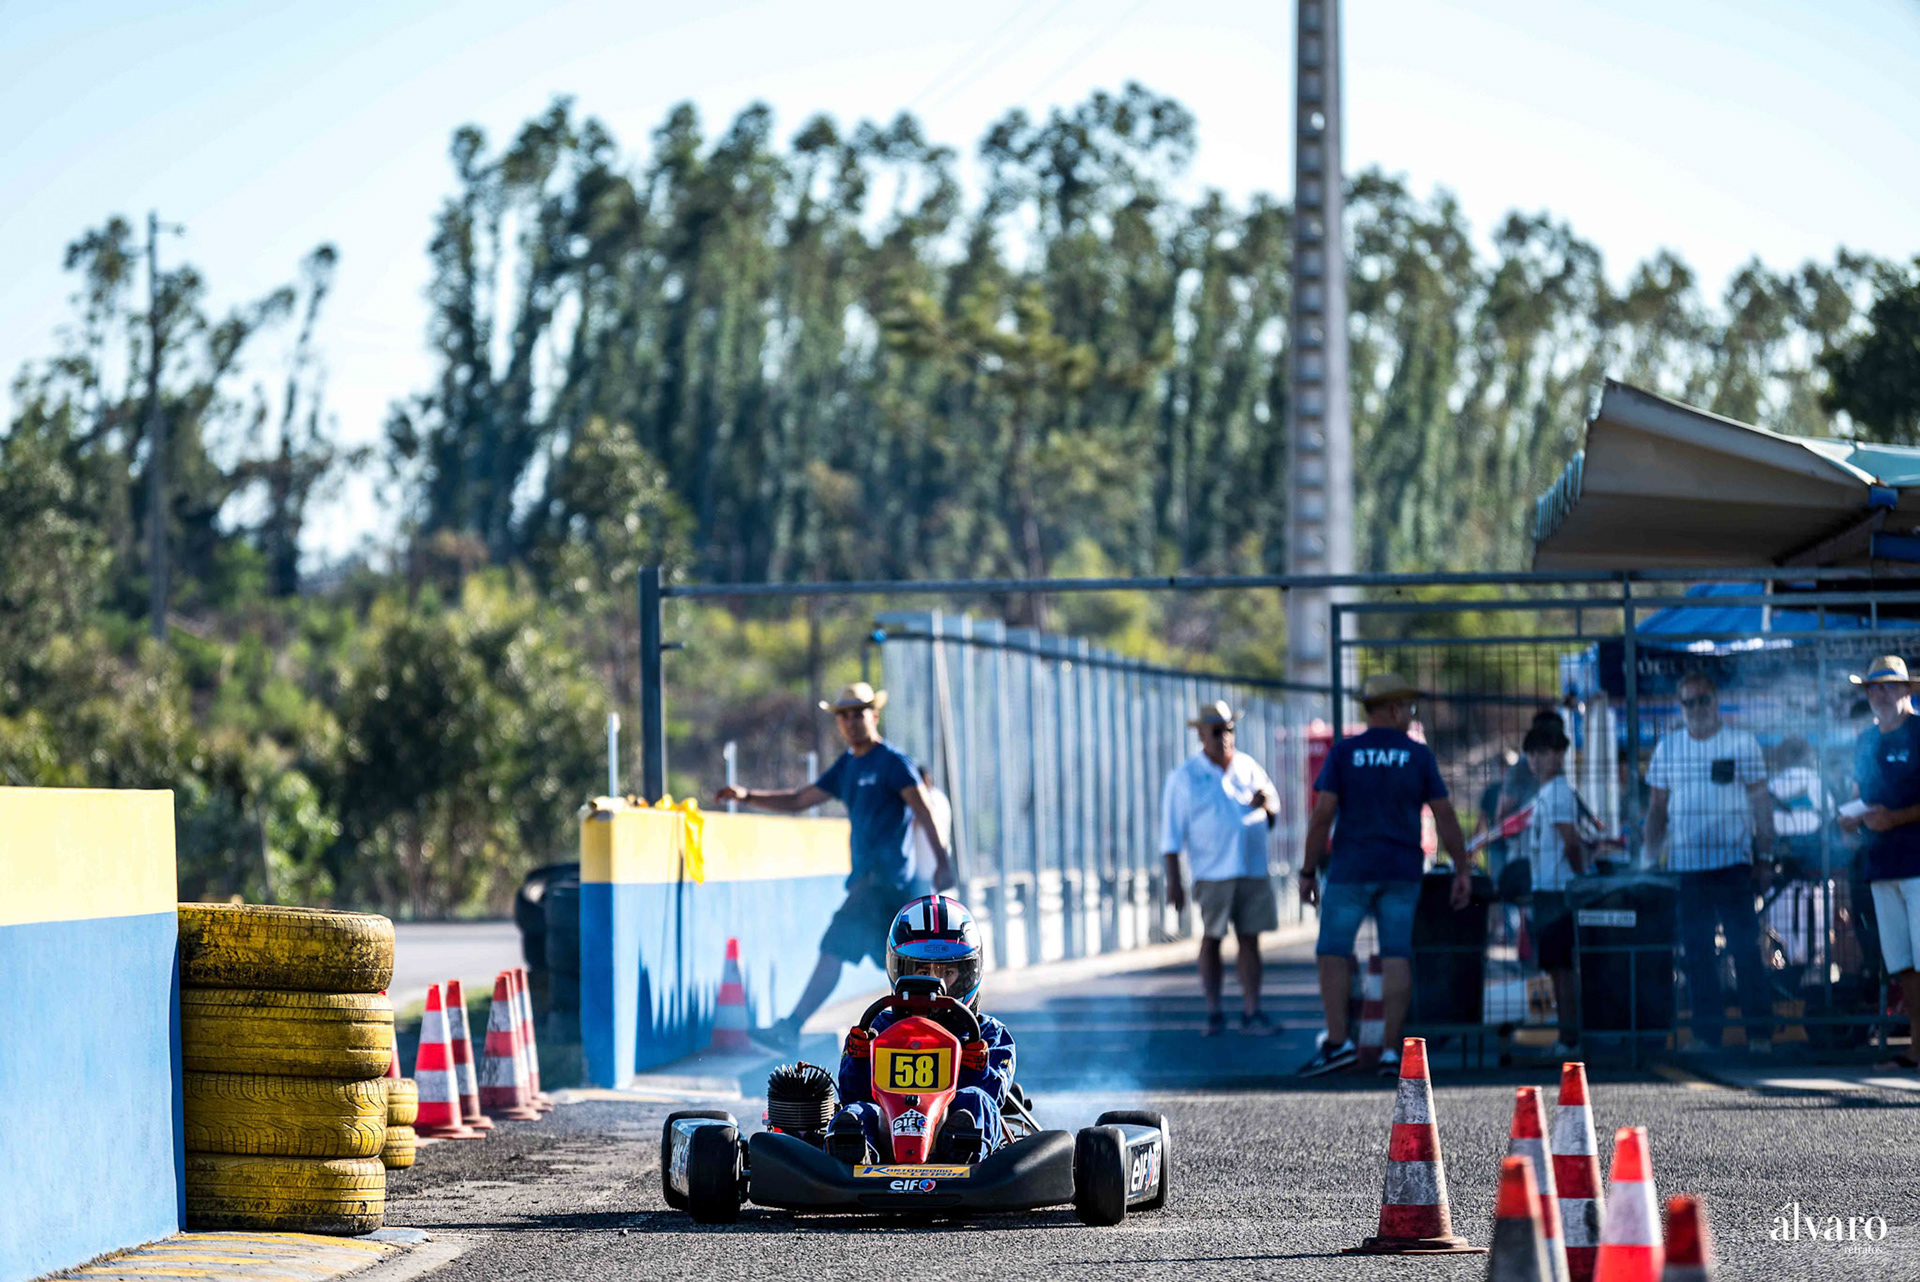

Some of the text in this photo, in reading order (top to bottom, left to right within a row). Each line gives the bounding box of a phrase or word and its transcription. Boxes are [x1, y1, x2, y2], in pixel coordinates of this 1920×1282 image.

[1353, 748, 1410, 768] STAFF
[895, 1055, 934, 1087] 58
[889, 1180, 920, 1191] elf
